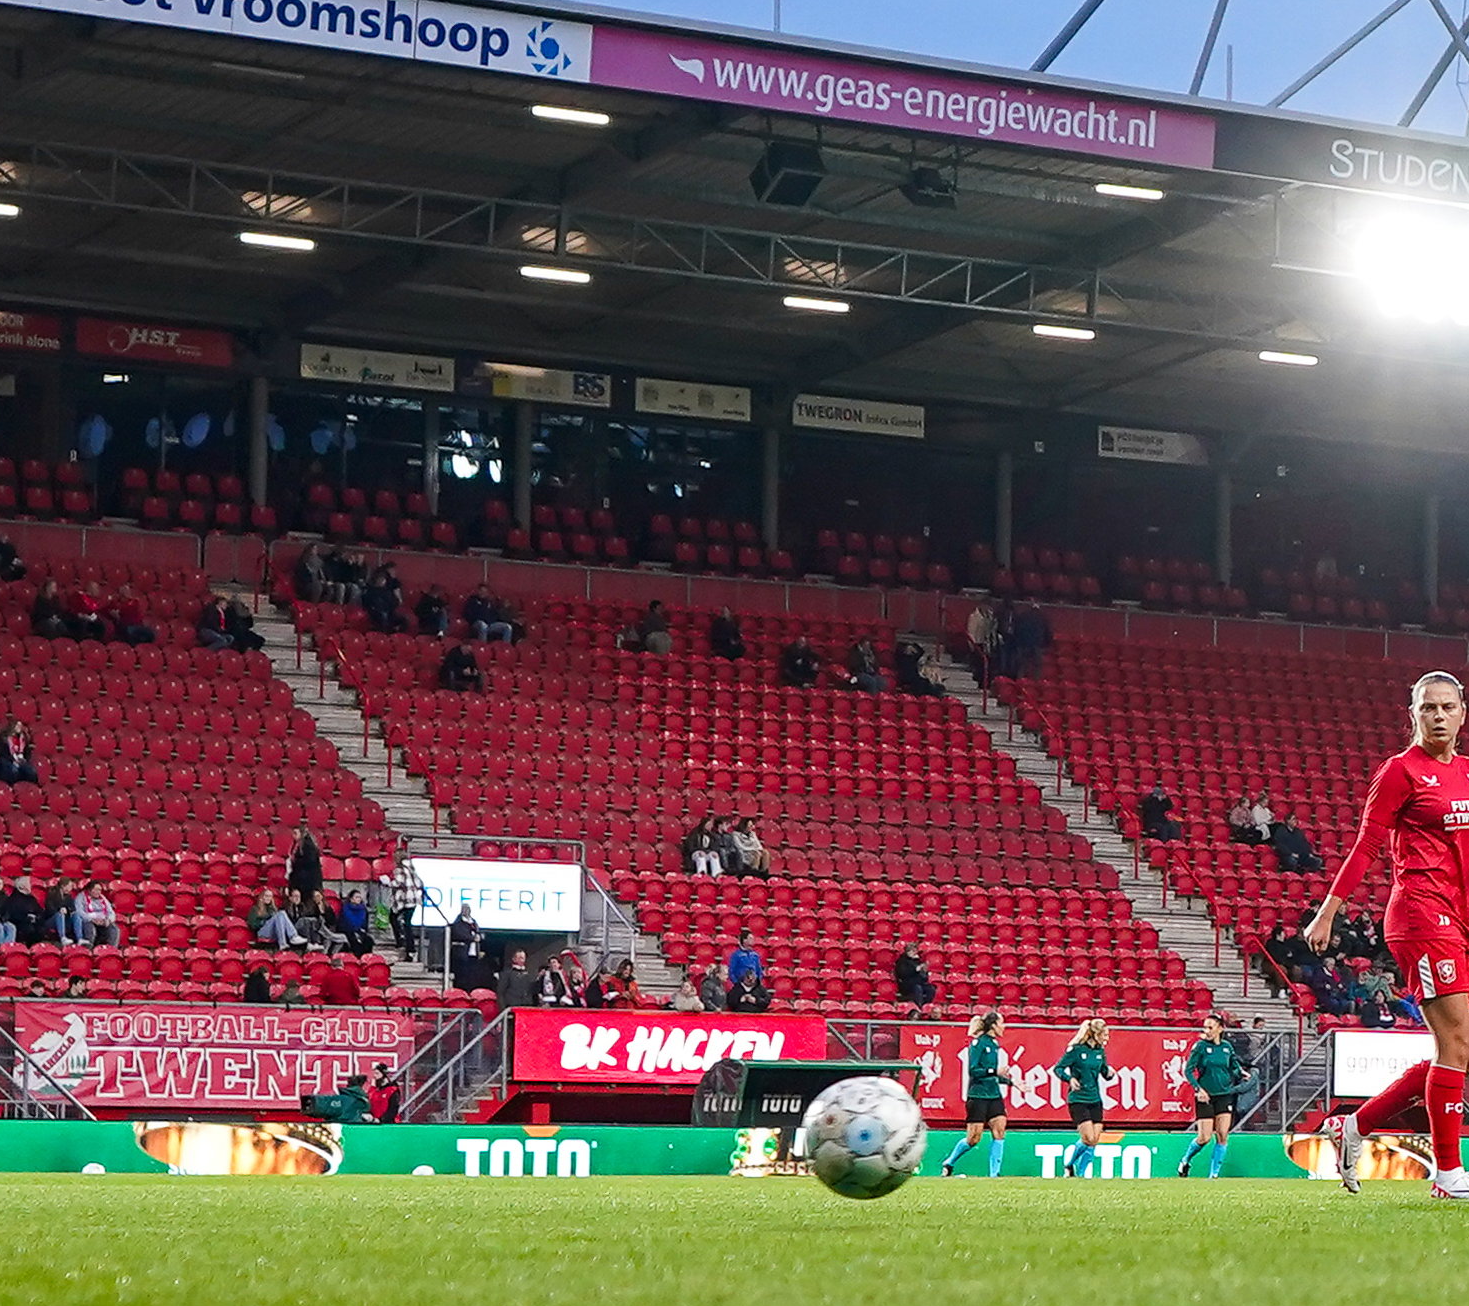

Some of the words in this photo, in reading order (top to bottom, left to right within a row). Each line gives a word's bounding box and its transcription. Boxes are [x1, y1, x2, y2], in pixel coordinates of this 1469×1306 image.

[713, 55, 1158, 150] www.geas-energiewacht.nl
[26, 332, 61, 351] alone
[131, 326, 180, 346] HST
[797, 401, 863, 423] TWEGRON
[422, 885, 564, 914] DIFFERIT
[84, 1011, 288, 1044] FOOTBALL
[301, 1016, 400, 1048] CLUB
[559, 1023, 621, 1070] BK
[87, 1047, 399, 1103] TWENTE
[456, 1138, 592, 1178] TOTO
